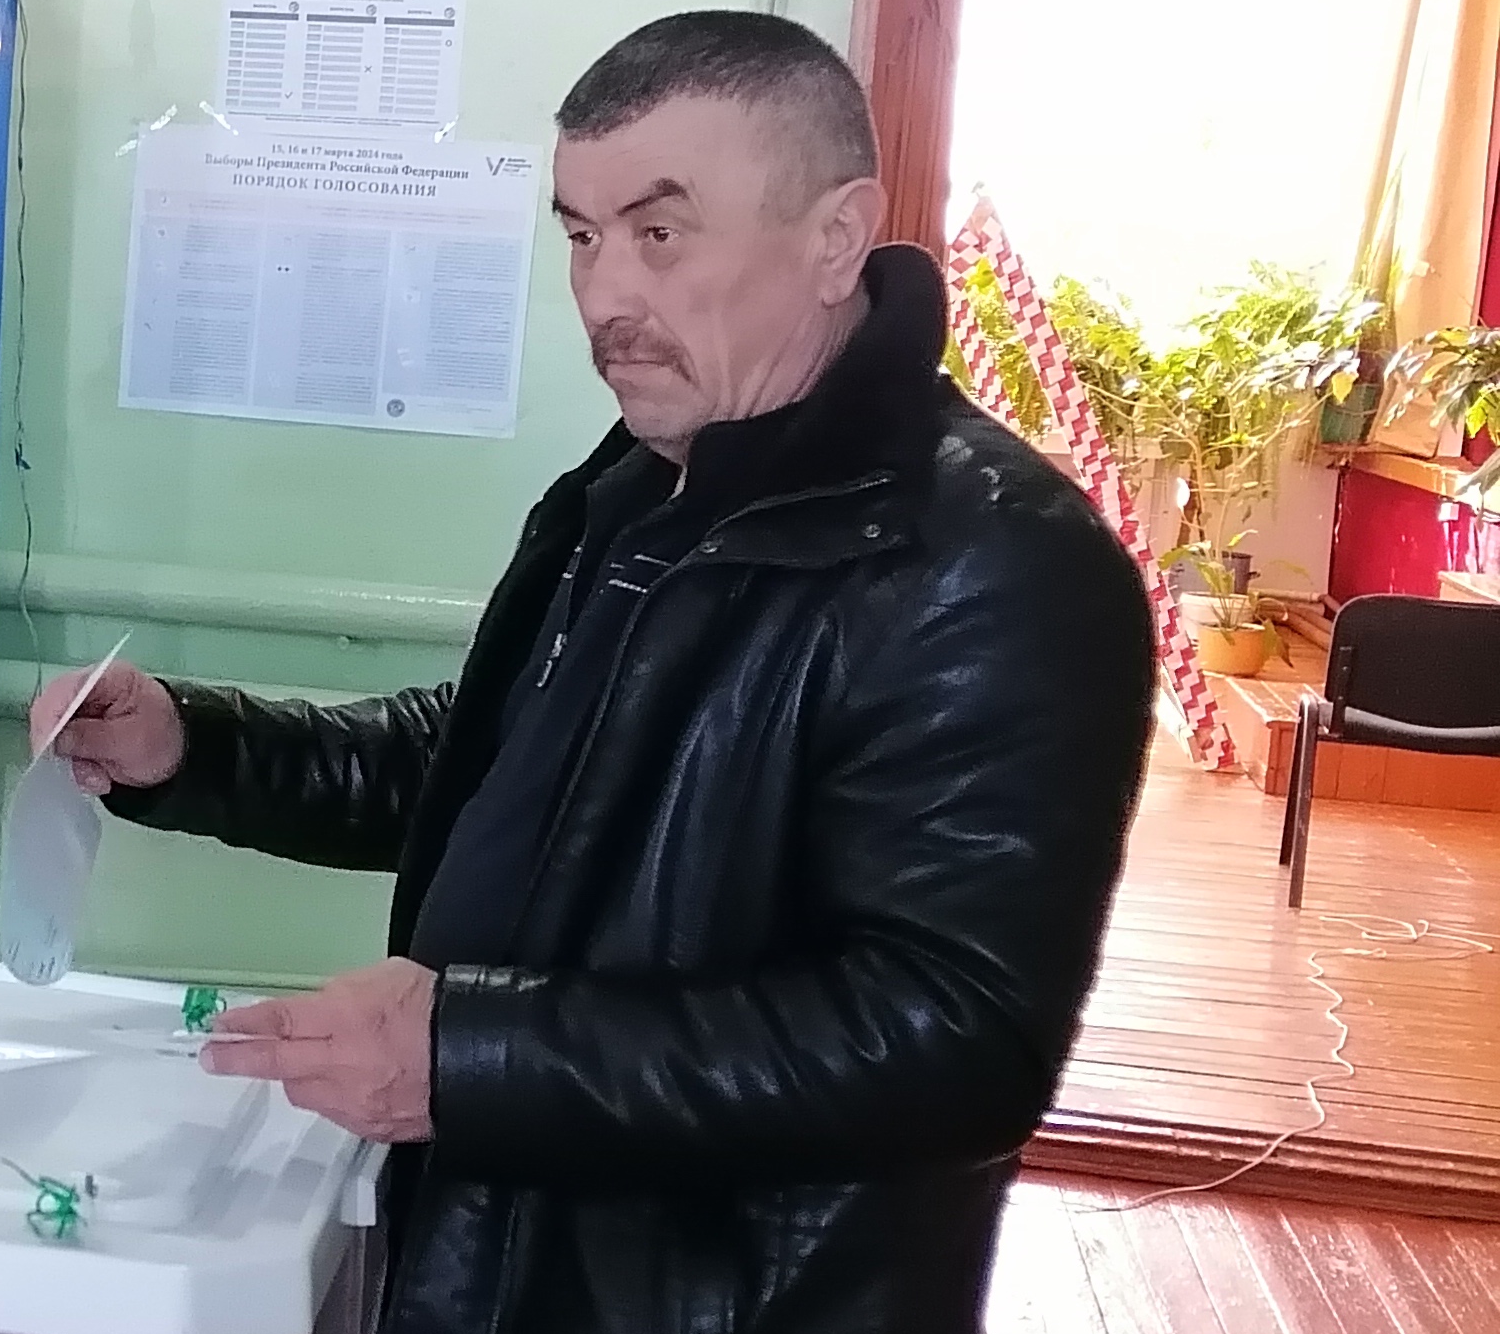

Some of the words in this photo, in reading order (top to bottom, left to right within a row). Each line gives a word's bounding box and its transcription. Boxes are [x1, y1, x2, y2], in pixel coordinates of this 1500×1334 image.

[288, 145, 300, 154] 16
[311, 146, 323, 155] 17
[324, 149, 354, 158] марта
[381, 152, 404, 161] года
[205, 153, 254, 168] Выборы
[257, 156, 327, 171] Президента
[329, 160, 399, 175] Российской
[401, 164, 469, 180] Федерации
[233, 173, 309, 189] ПОРЯДОК
[314, 178, 437, 197] ГОЛОСОВАНИЯ
